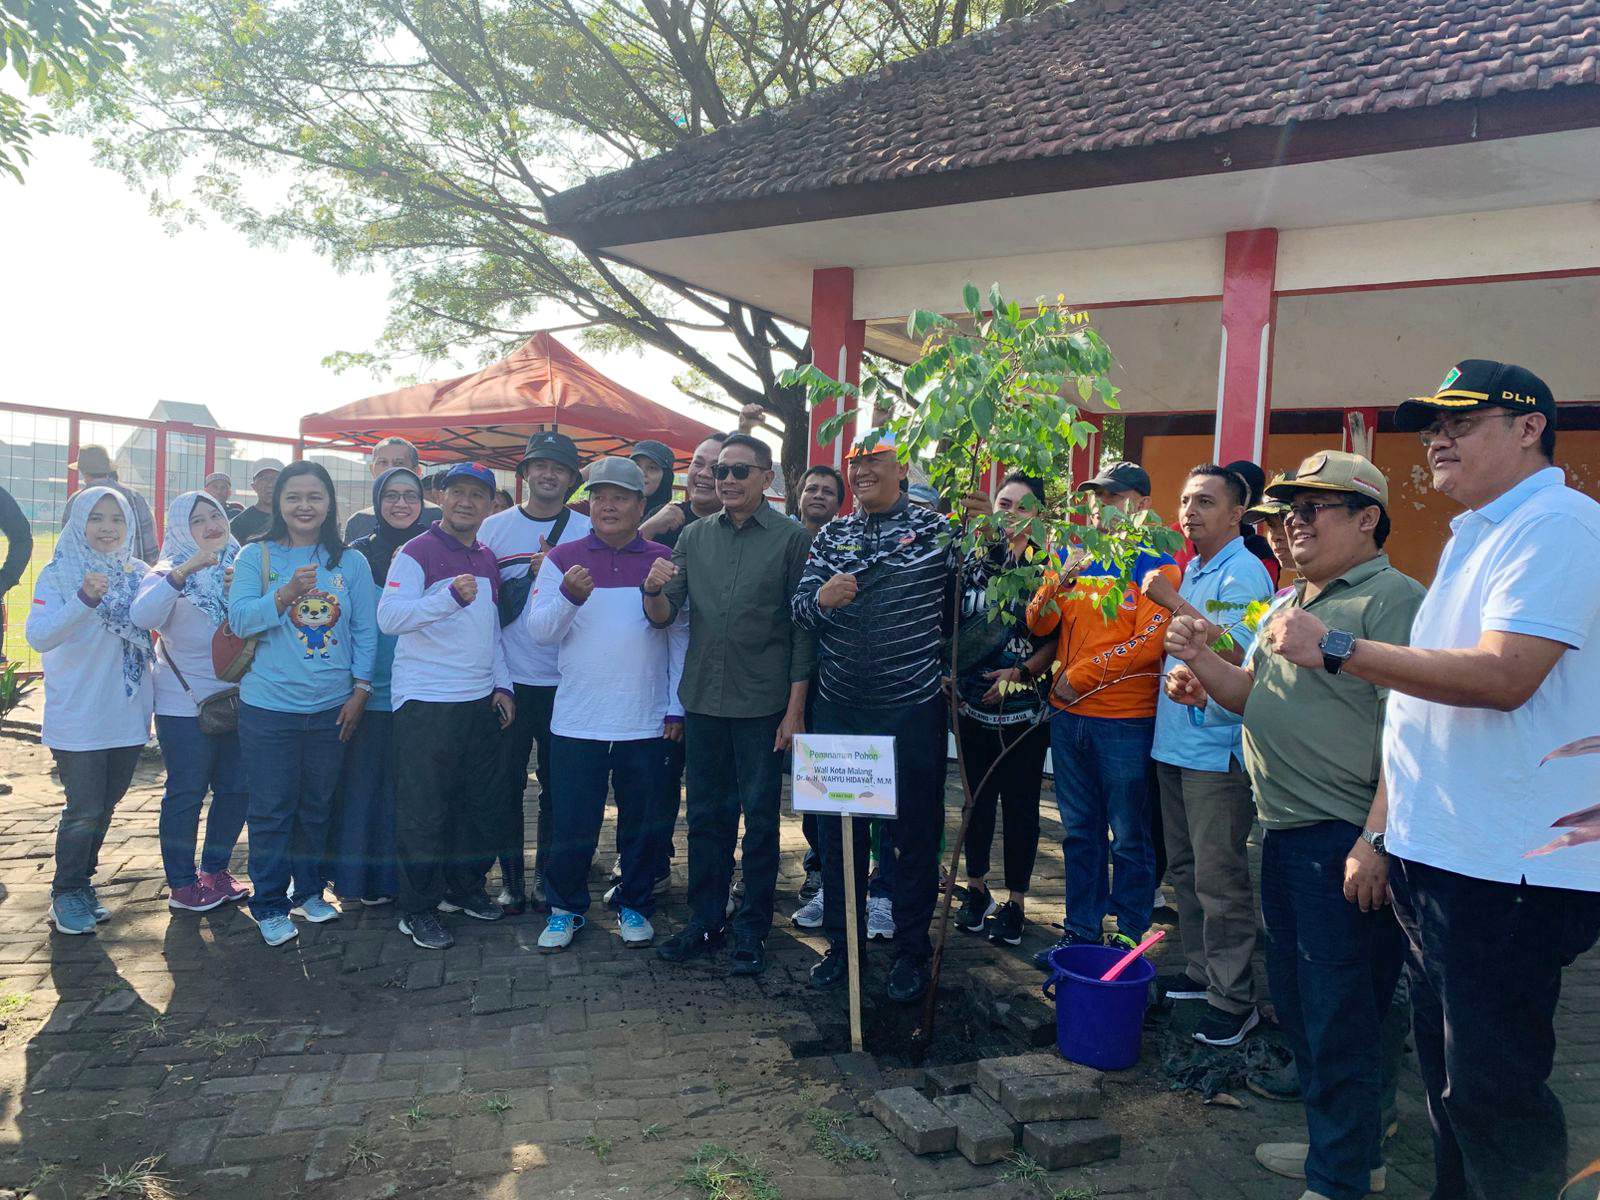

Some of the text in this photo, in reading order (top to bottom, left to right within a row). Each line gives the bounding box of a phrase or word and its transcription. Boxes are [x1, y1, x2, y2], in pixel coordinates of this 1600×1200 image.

[1502, 391, 1537, 405] DLH
[1011, 713, 1027, 722] JAVA
[854, 751, 878, 761] Pohon
[814, 766, 873, 778] Wali Kota Malang
[821, 775, 845, 783] WAHYU
